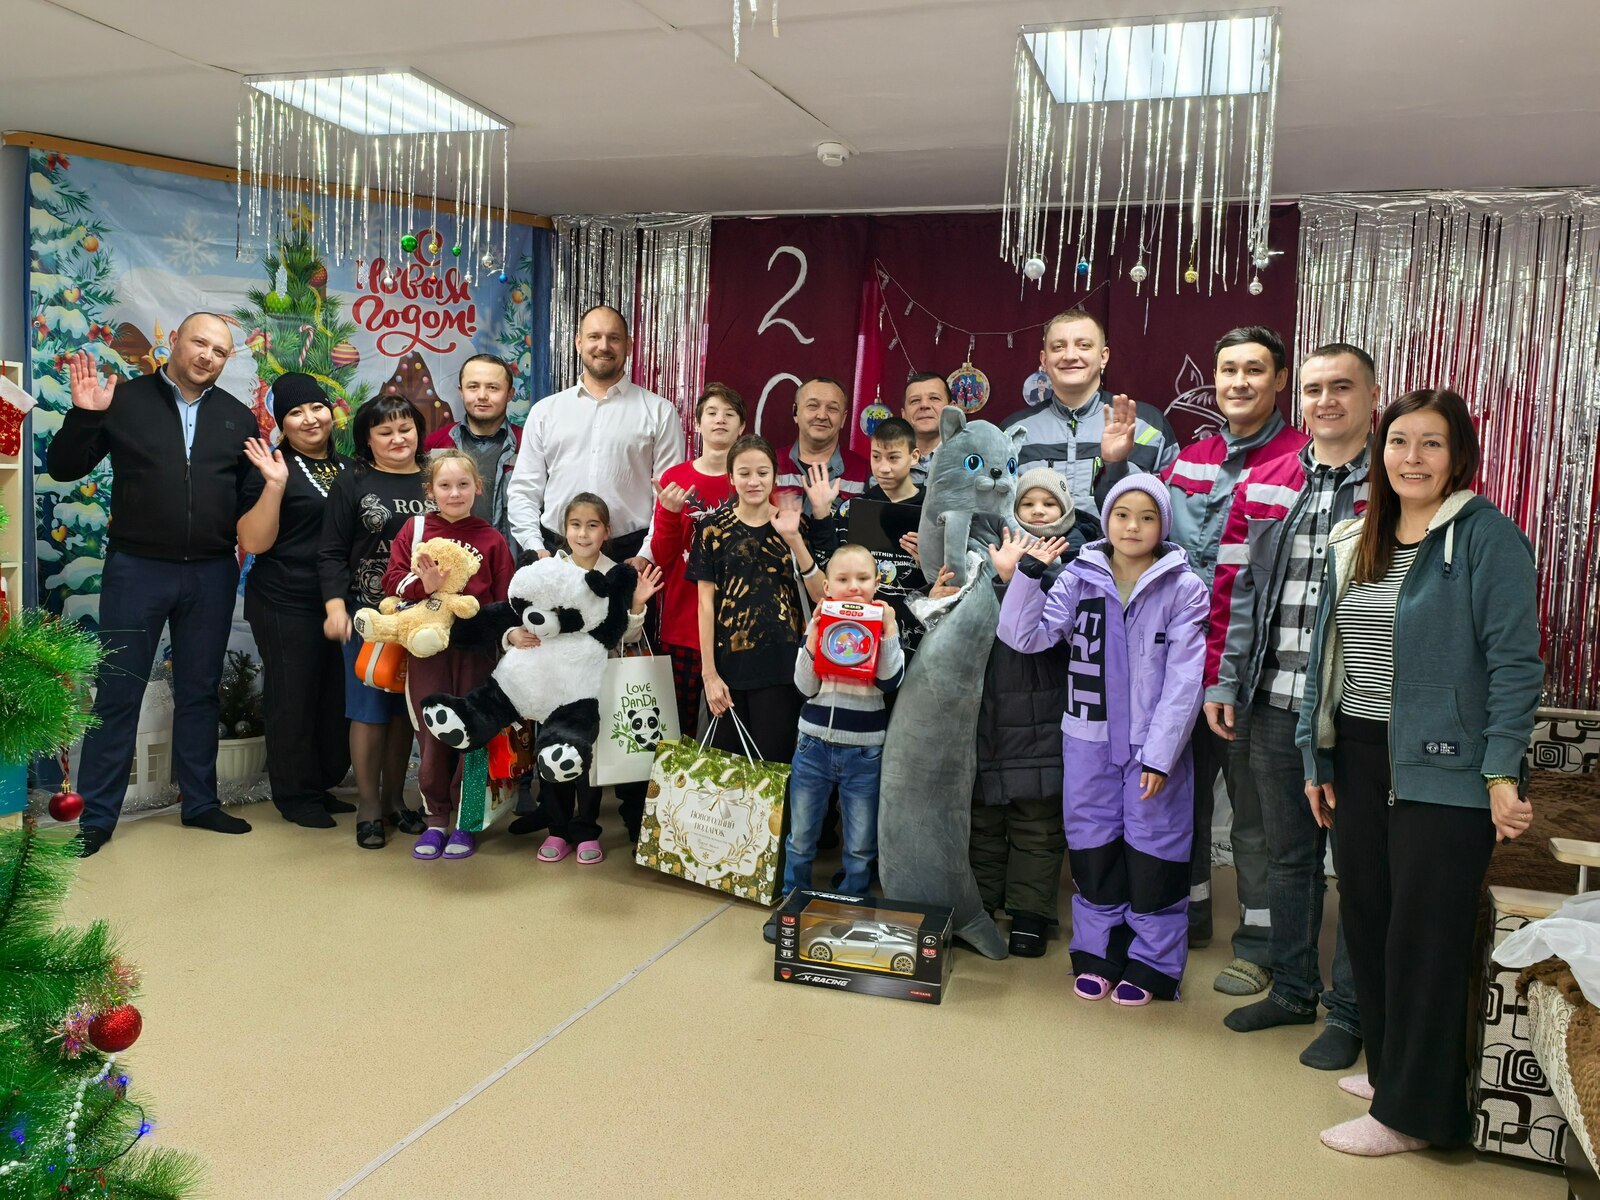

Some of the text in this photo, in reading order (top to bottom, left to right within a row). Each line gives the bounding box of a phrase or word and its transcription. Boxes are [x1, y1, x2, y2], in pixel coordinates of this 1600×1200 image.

[757, 246, 814, 344] 2
[392, 499, 440, 514] ROS
[450, 539, 483, 563] ARTS
[626, 682, 652, 695] LOVE
[802, 974, 848, 987] X-RACING
